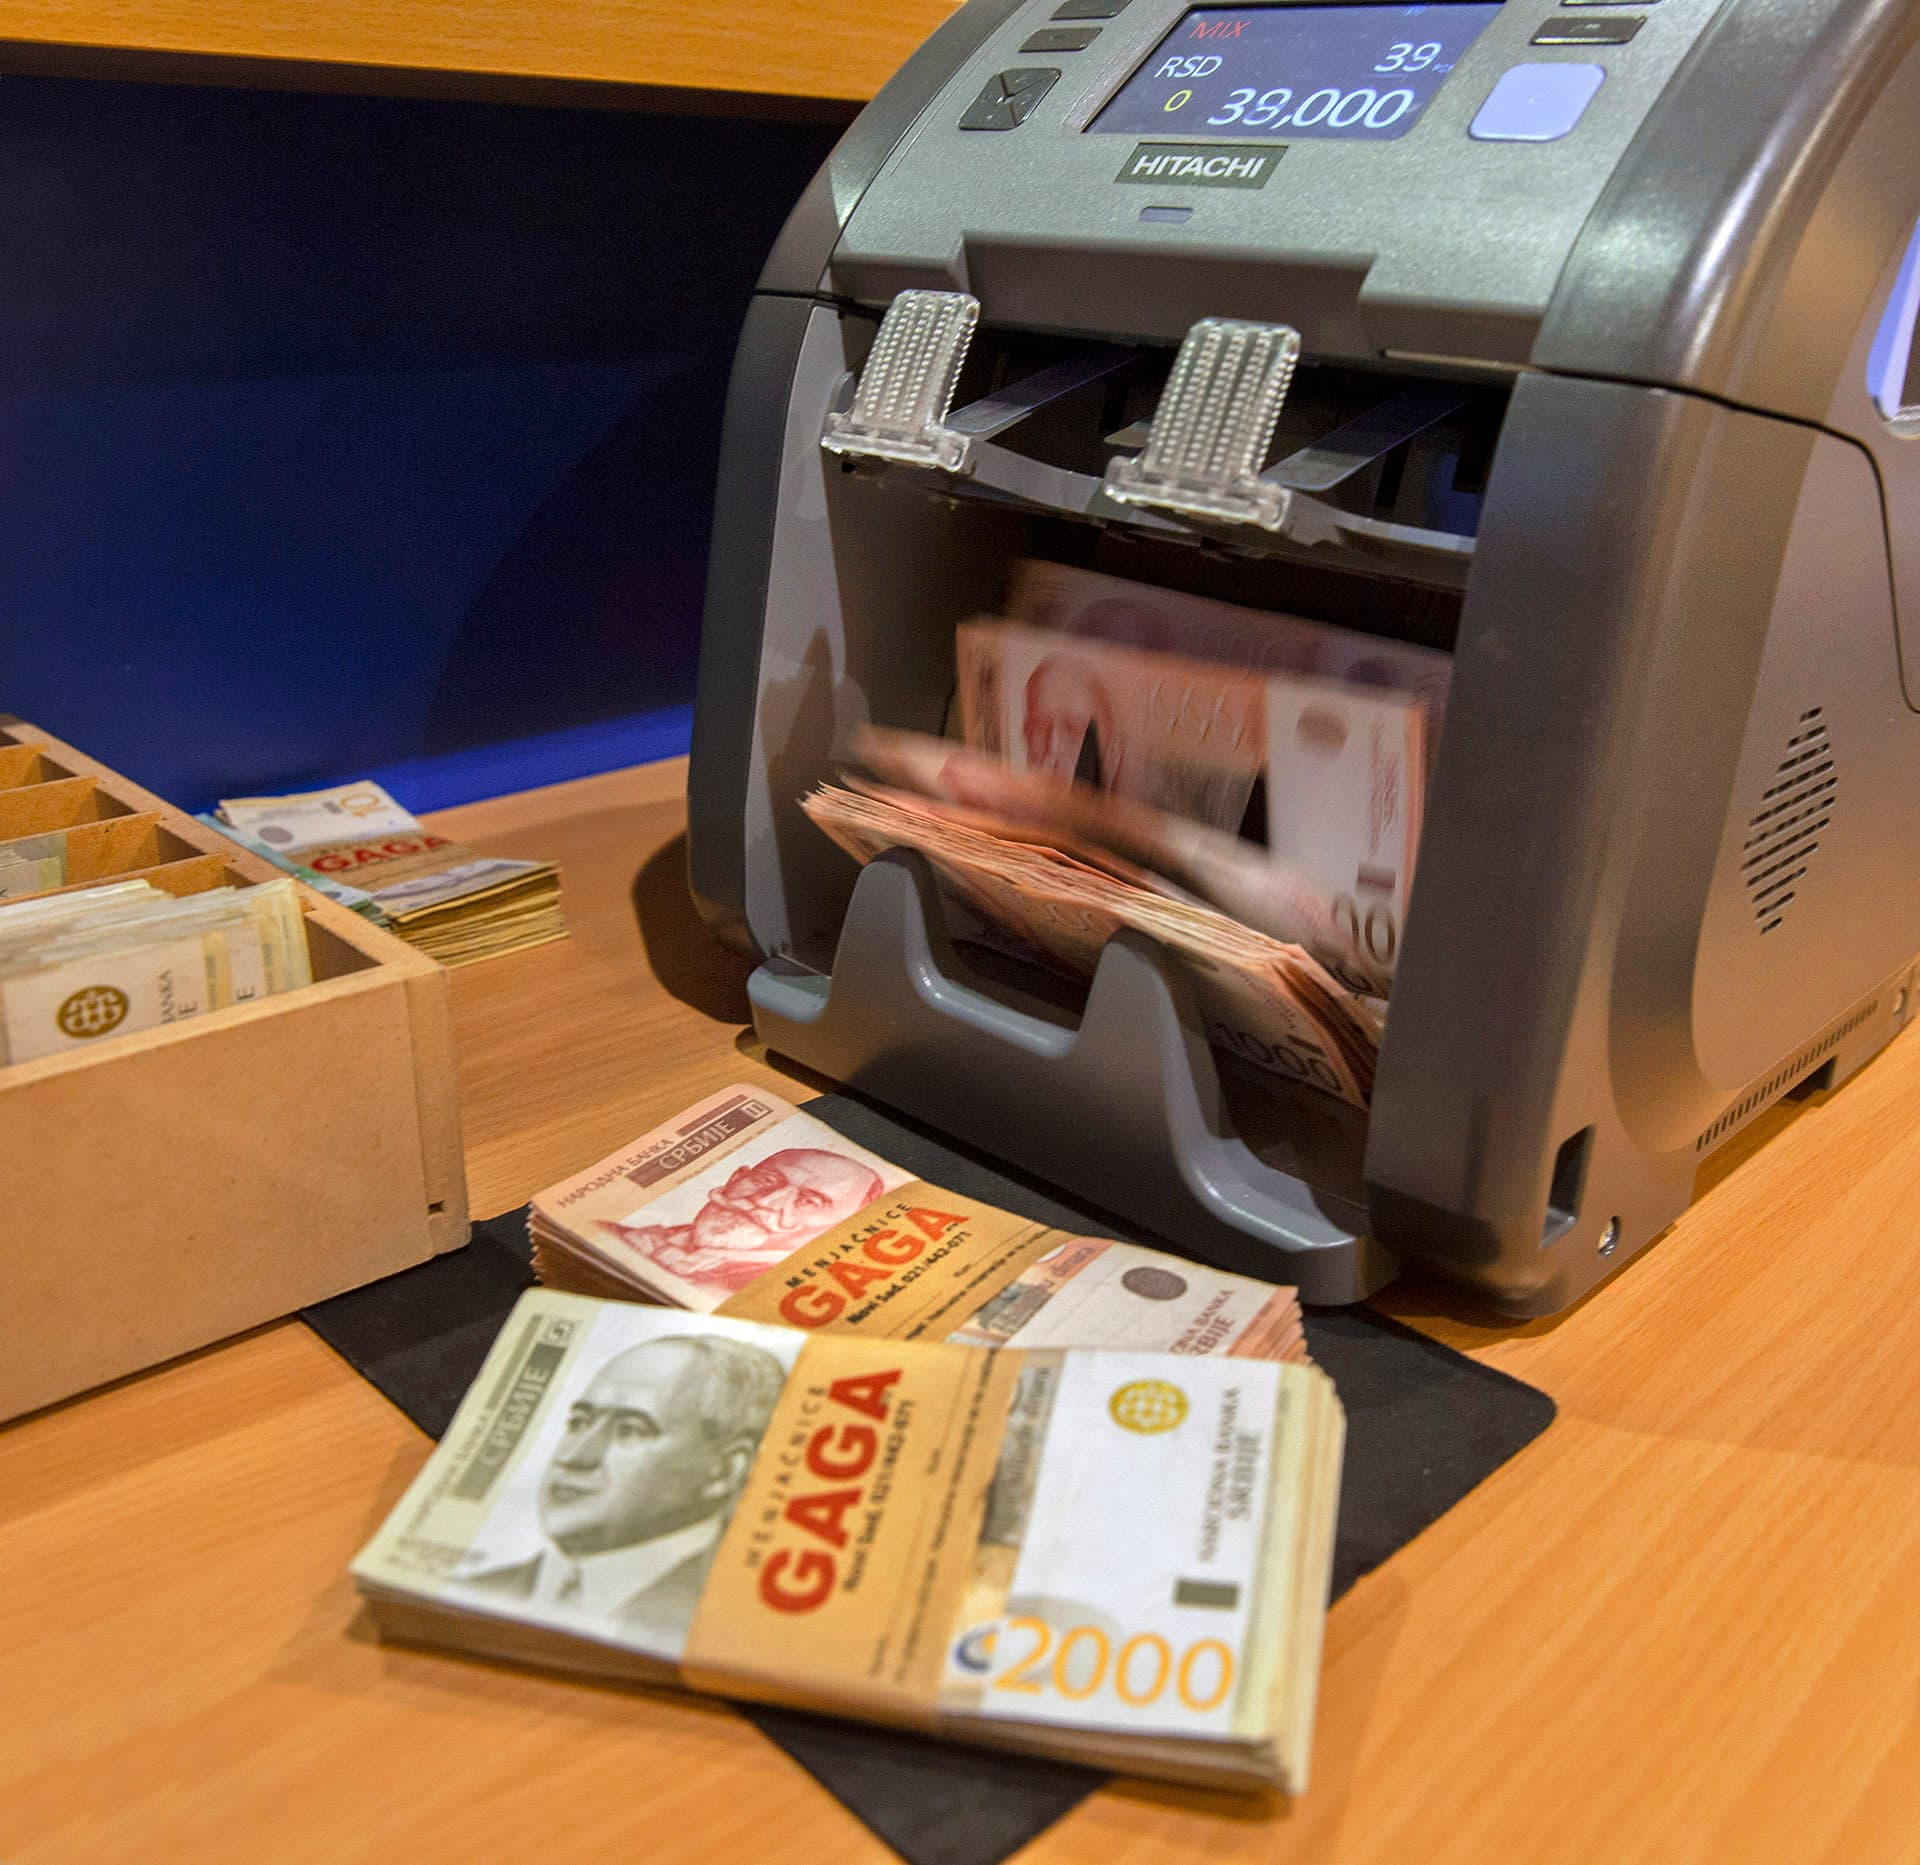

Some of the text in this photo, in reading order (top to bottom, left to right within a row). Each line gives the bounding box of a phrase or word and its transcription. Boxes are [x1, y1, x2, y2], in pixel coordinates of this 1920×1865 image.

[1189, 21, 1251, 39] MIX
[1155, 55, 1223, 78] RSD
[1374, 42, 1442, 72] 39
[1131, 153, 1267, 178] HITACHI
[309, 835, 453, 873] GAGA
[658, 1118, 736, 1170] СРБИЈЕ
[557, 1165, 630, 1208] НАРОДНА
[626, 1138, 674, 1168] БАНКА
[779, 1206, 969, 1329] GAGA
[784, 1201, 914, 1290] MENJAČNICE
[757, 1368, 903, 1617] GAGA
[993, 1614, 1237, 1715] 2000
